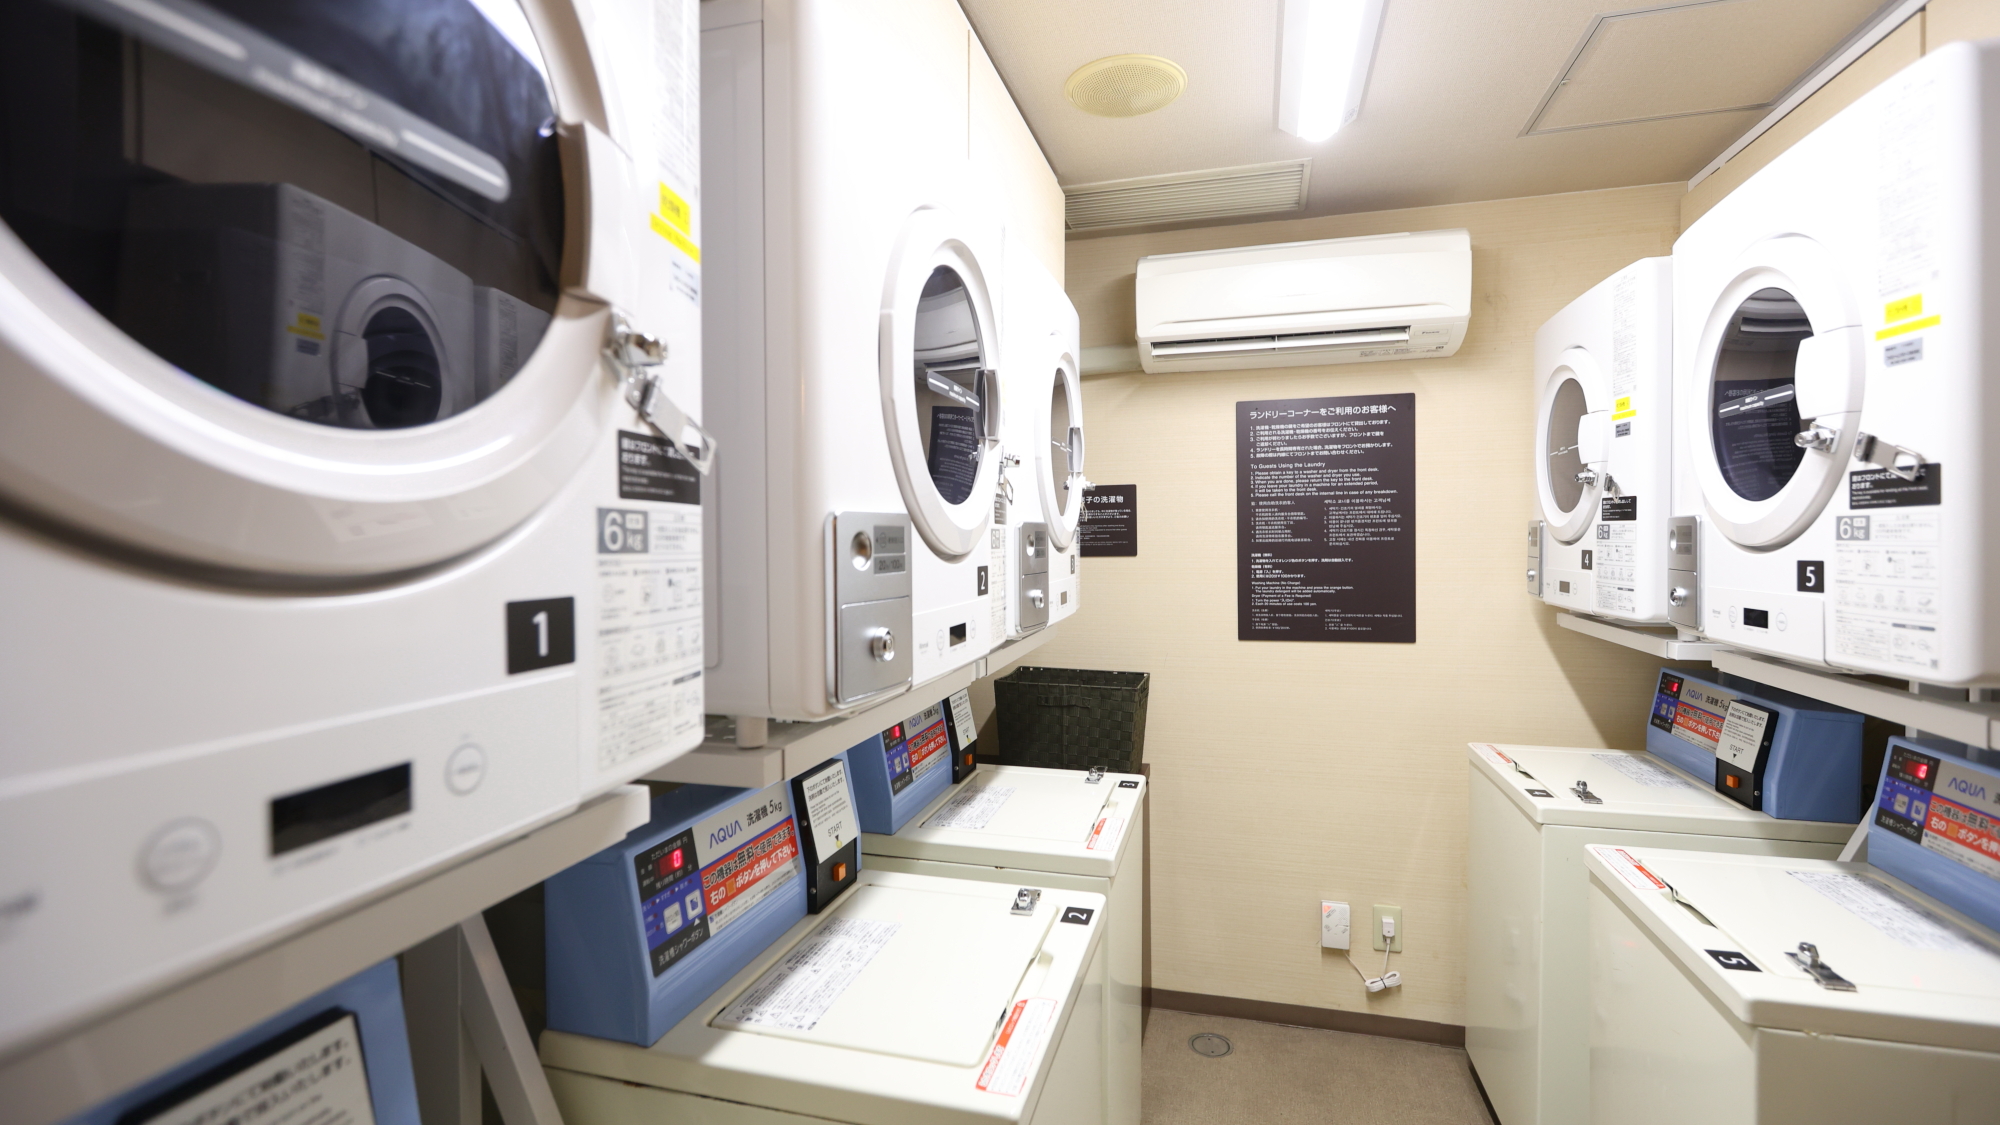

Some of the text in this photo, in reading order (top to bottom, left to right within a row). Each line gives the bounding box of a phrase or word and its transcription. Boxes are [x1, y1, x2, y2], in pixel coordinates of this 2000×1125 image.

[1250, 404, 1397, 420] ランドリーコーナーをご利用のお客様へ
[604, 512, 644, 551] 6 kg
[1598, 527, 1603, 538] 6
[1840, 517, 1865, 539] 6 kg
[1584, 554, 1589, 566] 4
[981, 571, 986, 590] 2
[1806, 566, 1815, 587] 5
[532, 612, 549, 657] 1
[1686, 689, 1703, 701] AQUA
[1705, 695, 1718, 706] 洗濯機
[1729, 744, 1744, 754] START
[1948, 777, 1986, 800] AQUA
[747, 800, 783, 826] 洗濯機 5kg
[828, 821, 842, 838] START
[1930, 817, 1947, 831] 右の
[710, 820, 742, 849] AQUA
[673, 848, 682, 868] 0
[703, 826, 794, 889] この機器は無料で使用できます。
[710, 884, 726, 905] 右の
[736, 844, 795, 888] ボタンを押して下さい。
[1068, 912, 1087, 920] 2
[1719, 956, 1747, 965] 5
